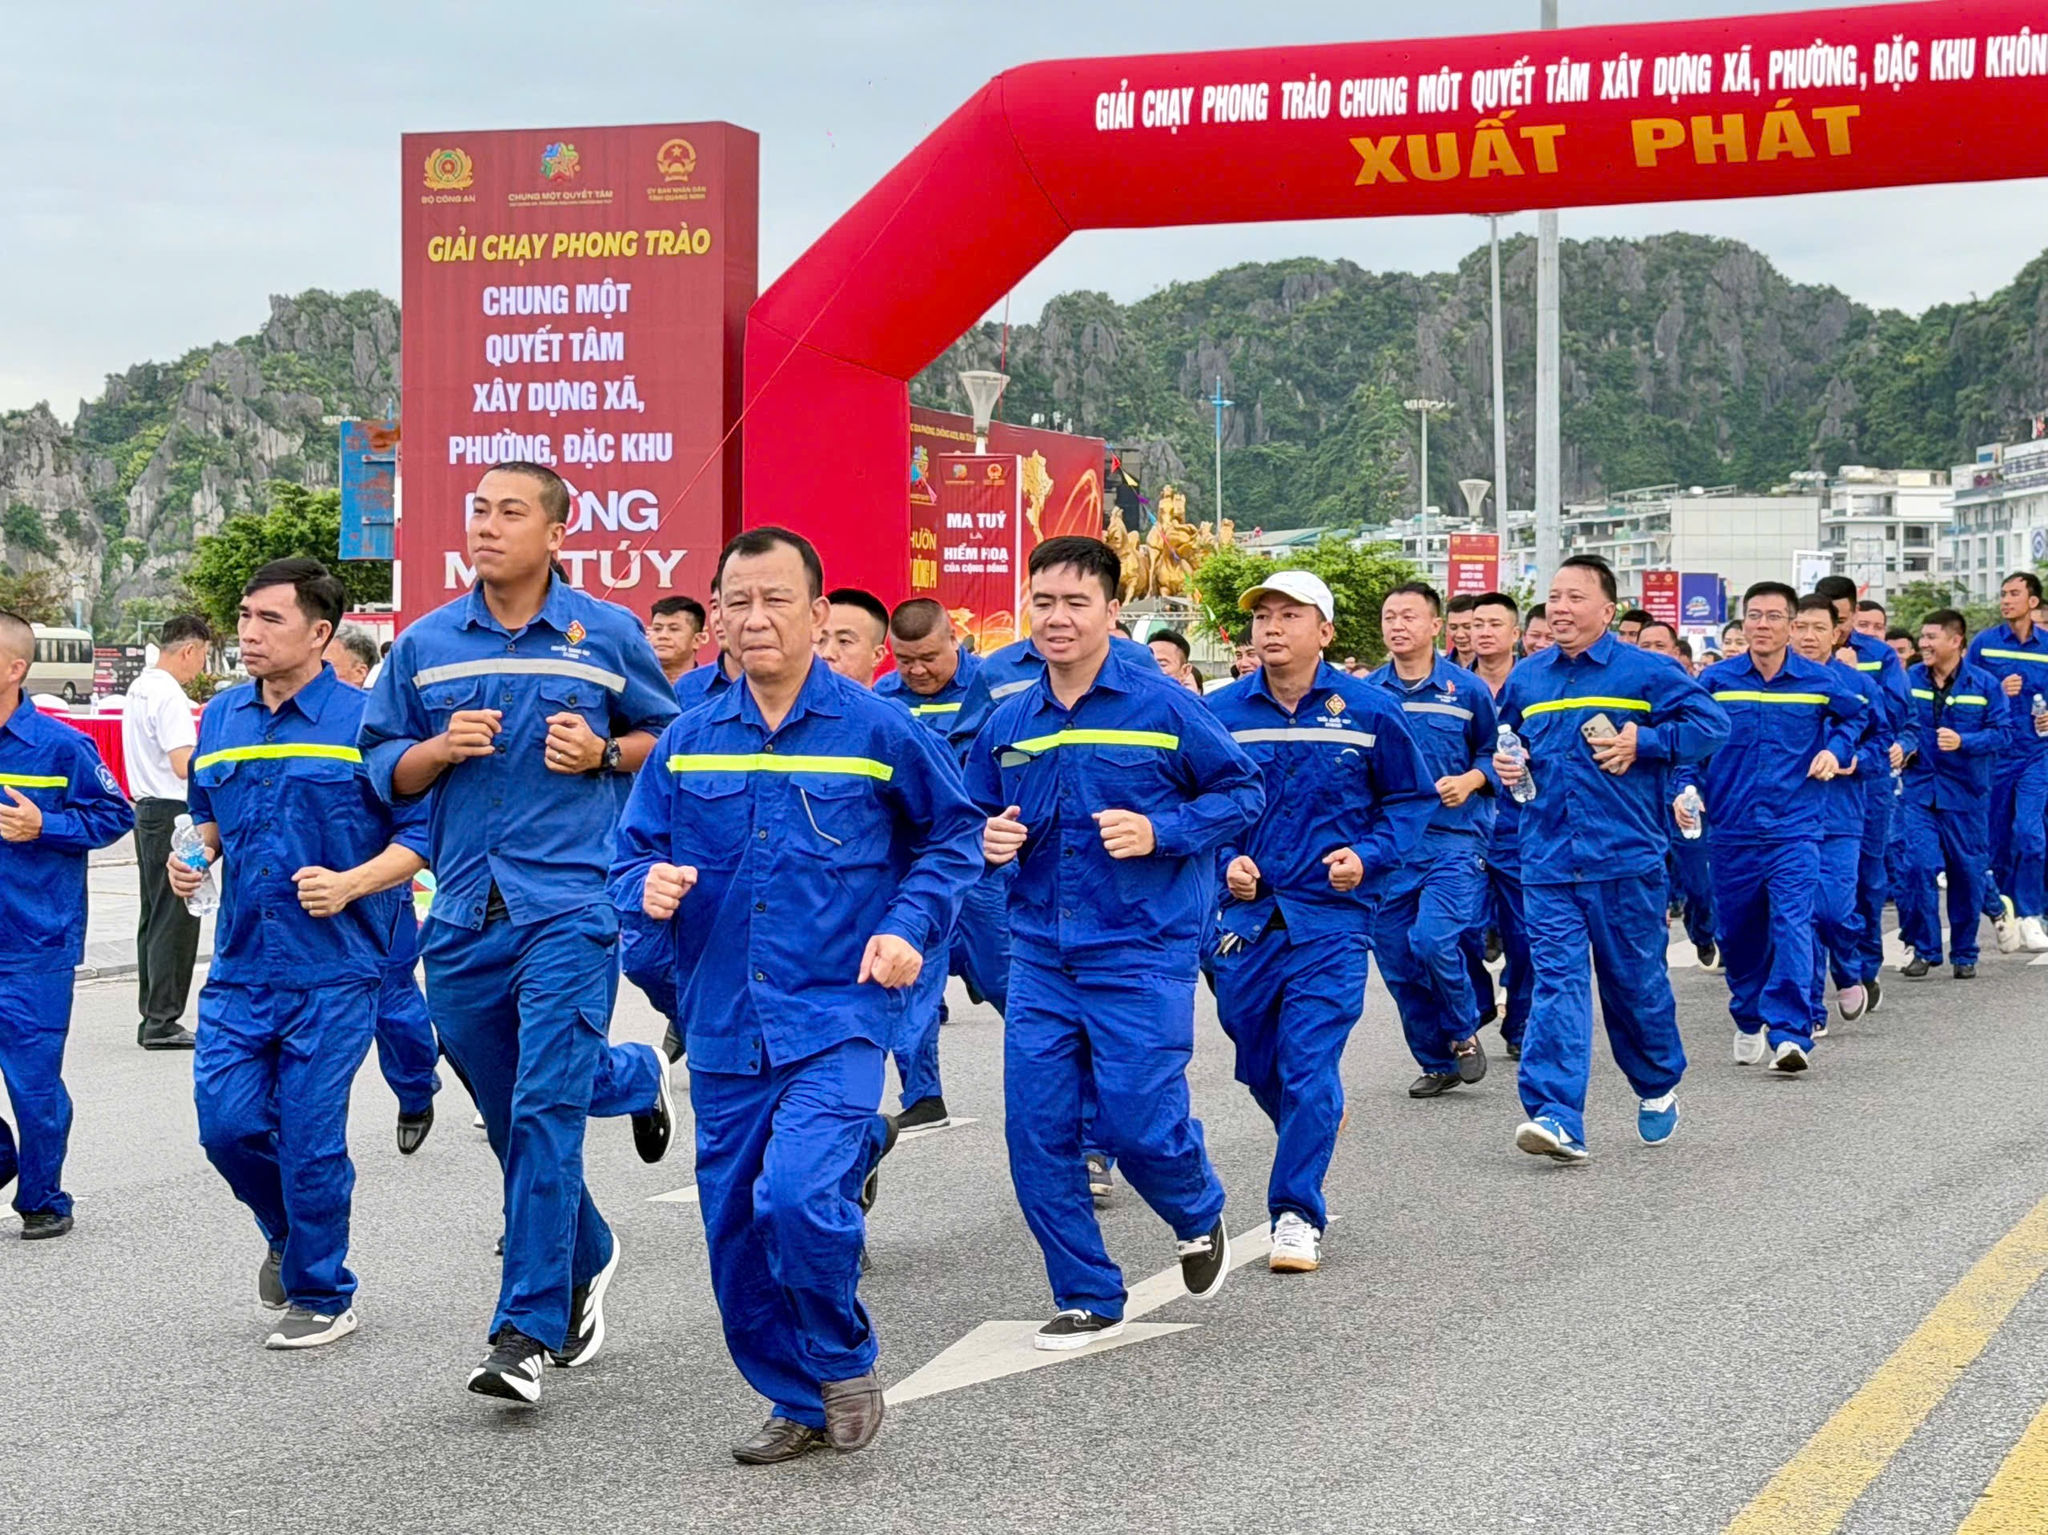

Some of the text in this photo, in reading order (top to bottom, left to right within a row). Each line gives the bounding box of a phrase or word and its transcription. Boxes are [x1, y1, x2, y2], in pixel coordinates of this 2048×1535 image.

[1095, 79, 1134, 131] GIẢI
[1142, 87, 1195, 134] CHẠY
[1201, 82, 1269, 123] PHONG
[1281, 73, 1332, 120] TRÀO
[1339, 77, 1408, 118] CHUNG
[1471, 56, 1536, 114] QUYẾT
[1545, 56, 1590, 103] TÂM
[1600, 52, 1643, 99] XÂY
[1653, 51, 1712, 104] DỰNG
[1721, 45, 1761, 97] XÃ,
[1768, 38, 1868, 91] PHƯỜNG,
[1873, 34, 1919, 92] ĐẶC
[1929, 38, 1976, 82] KHU
[1347, 97, 1861, 187] XUẤT PHÁT
[435, 194, 462, 204] CÔNG
[462, 194, 476, 203] AN
[508, 188, 614, 202] CHUNG MỘT QUYẾT TÂM
[427, 221, 711, 266] GIẢI CHẠY PHONG TRÀO
[482, 277, 632, 319] CHUNG MỘT
[485, 324, 624, 367] QUYẾT TÂM
[473, 375, 646, 417] XÂY DỰNG XÃ,
[449, 428, 673, 469] PHƯỜNG, ĐẶC KHU
[946, 510, 1007, 529] MA TUÝ
[557, 540, 688, 589] TÚY
[981, 547, 1009, 563] HOẠ
